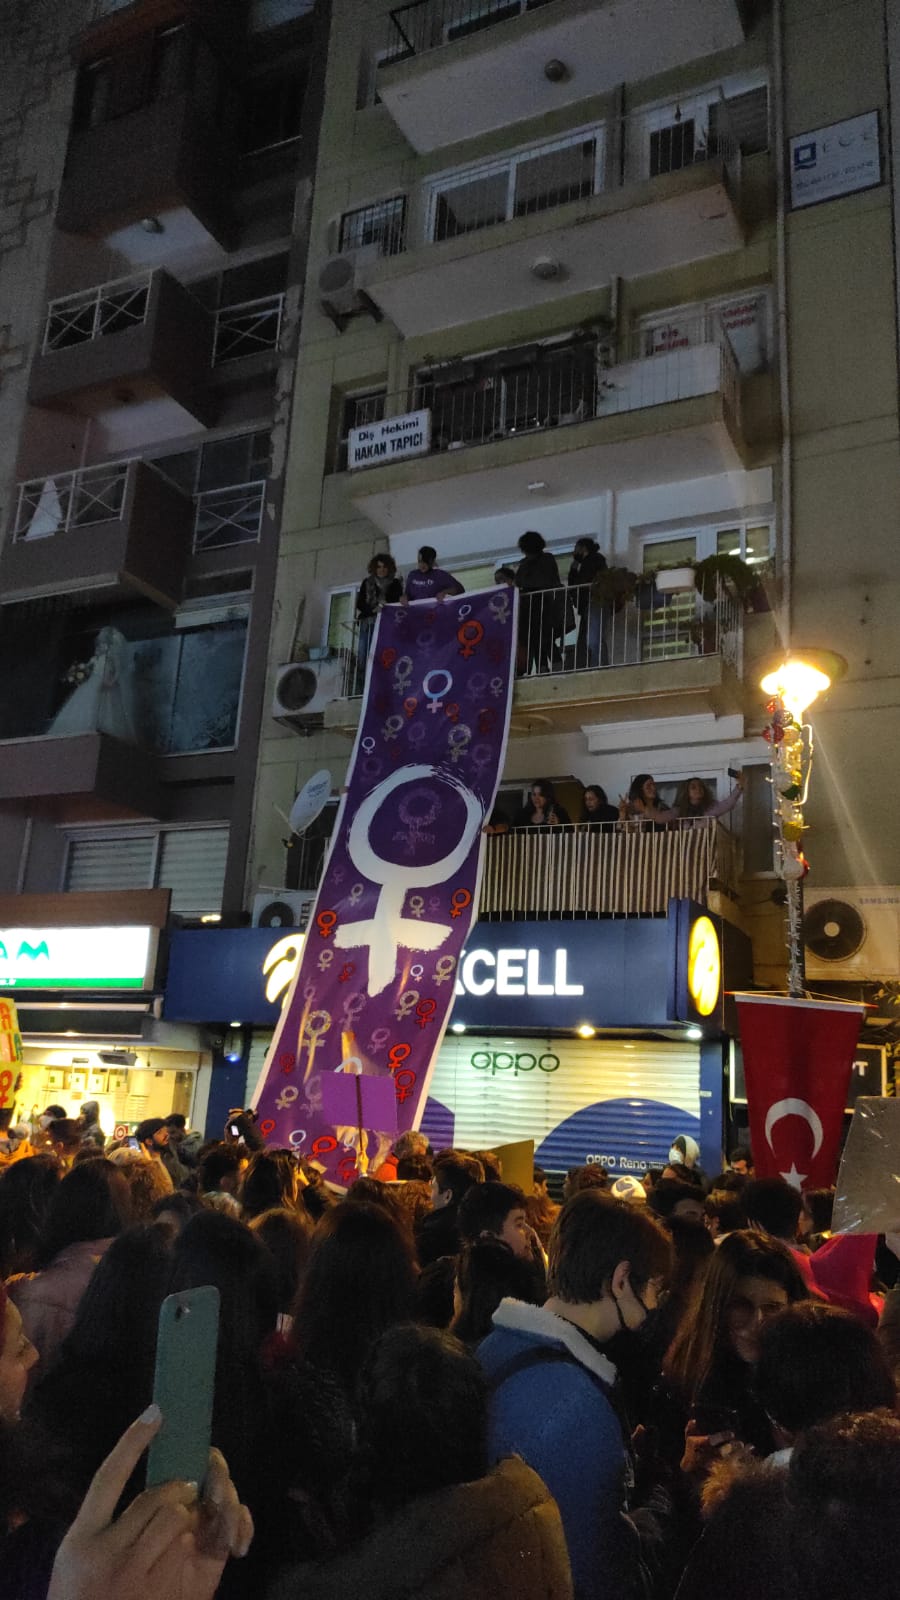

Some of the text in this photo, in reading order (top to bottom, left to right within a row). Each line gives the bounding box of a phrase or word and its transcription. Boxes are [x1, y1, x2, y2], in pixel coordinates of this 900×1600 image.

[358, 417, 419, 442] Diş Hekimi
[354, 432, 423, 462] HAKAN TAPICI
[455, 948, 584, 996] CELL
[586, 1154, 616, 1167] OPPO
[620, 1156, 647, 1170] Reno
